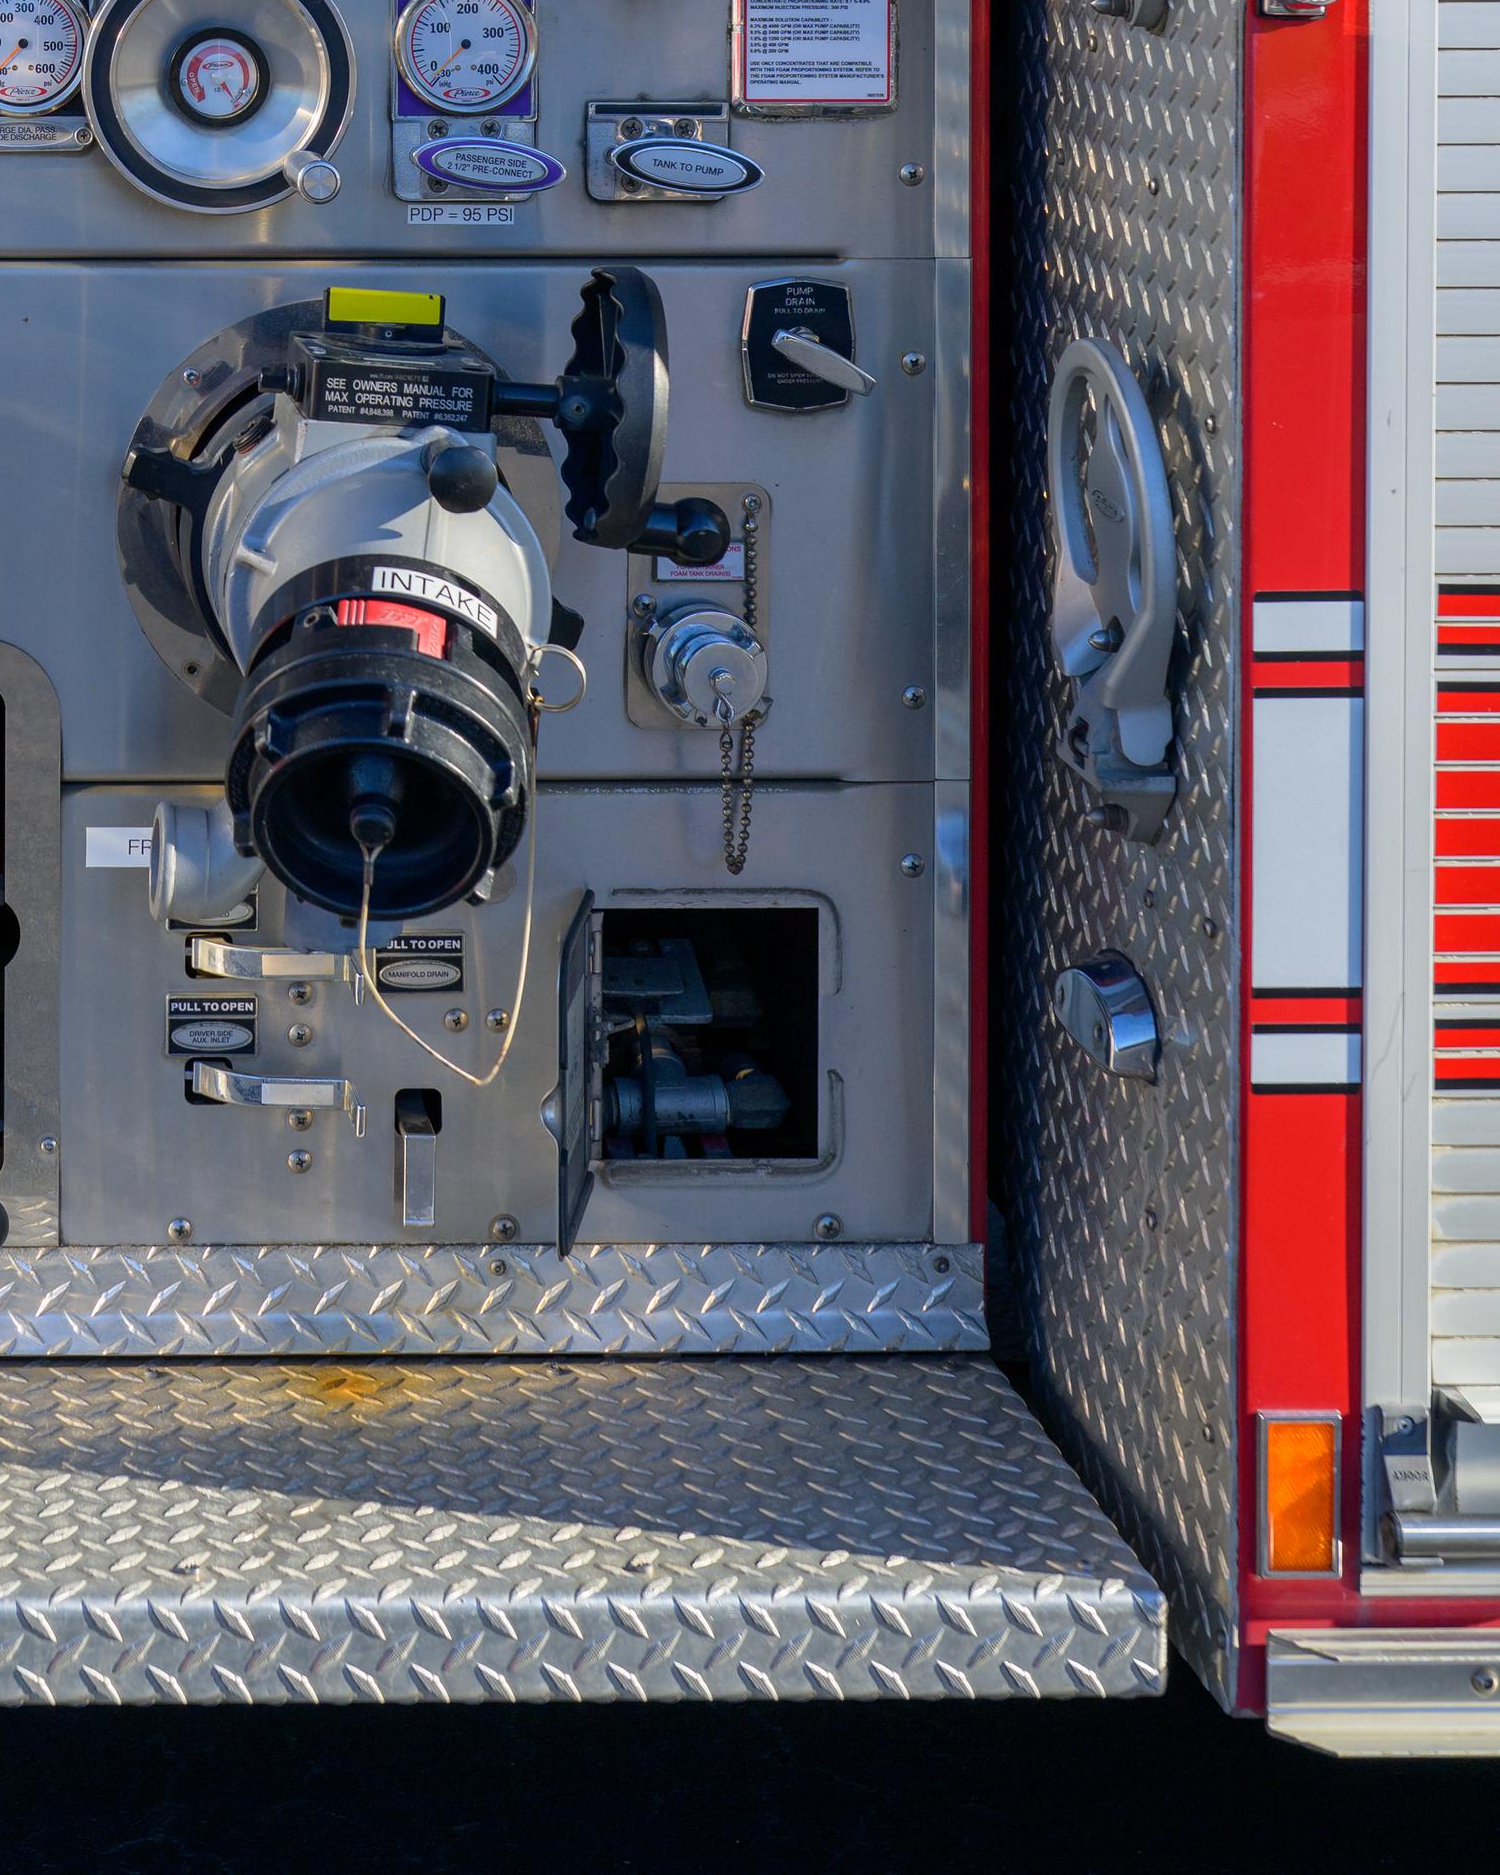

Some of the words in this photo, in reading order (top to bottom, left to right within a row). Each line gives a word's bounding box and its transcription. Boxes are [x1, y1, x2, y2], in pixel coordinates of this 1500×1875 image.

[652, 158, 675, 171] TANK
[676, 161, 693, 172] TO
[694, 163, 724, 177] PUMP
[786, 286, 814, 296] PUMP
[785, 297, 816, 306] DRAIN
[326, 377, 347, 390] SEE
[352, 379, 398, 393] OWNERS
[403, 383, 446, 398] MANUAL
[451, 386, 474, 399] FOR
[325, 390, 349, 404] MAX
[355, 392, 413, 408] OPERATING
[418, 397, 473, 412] PRESSURE
[380, 570, 495, 631] INTAKE
[388, 970, 428, 979] MANIFOLD
[428, 970, 449, 979] DRAIN
[170, 1001, 200, 1012] PULL
[202, 1001, 220, 1012] TO
[221, 1001, 254, 1012] OPEN
